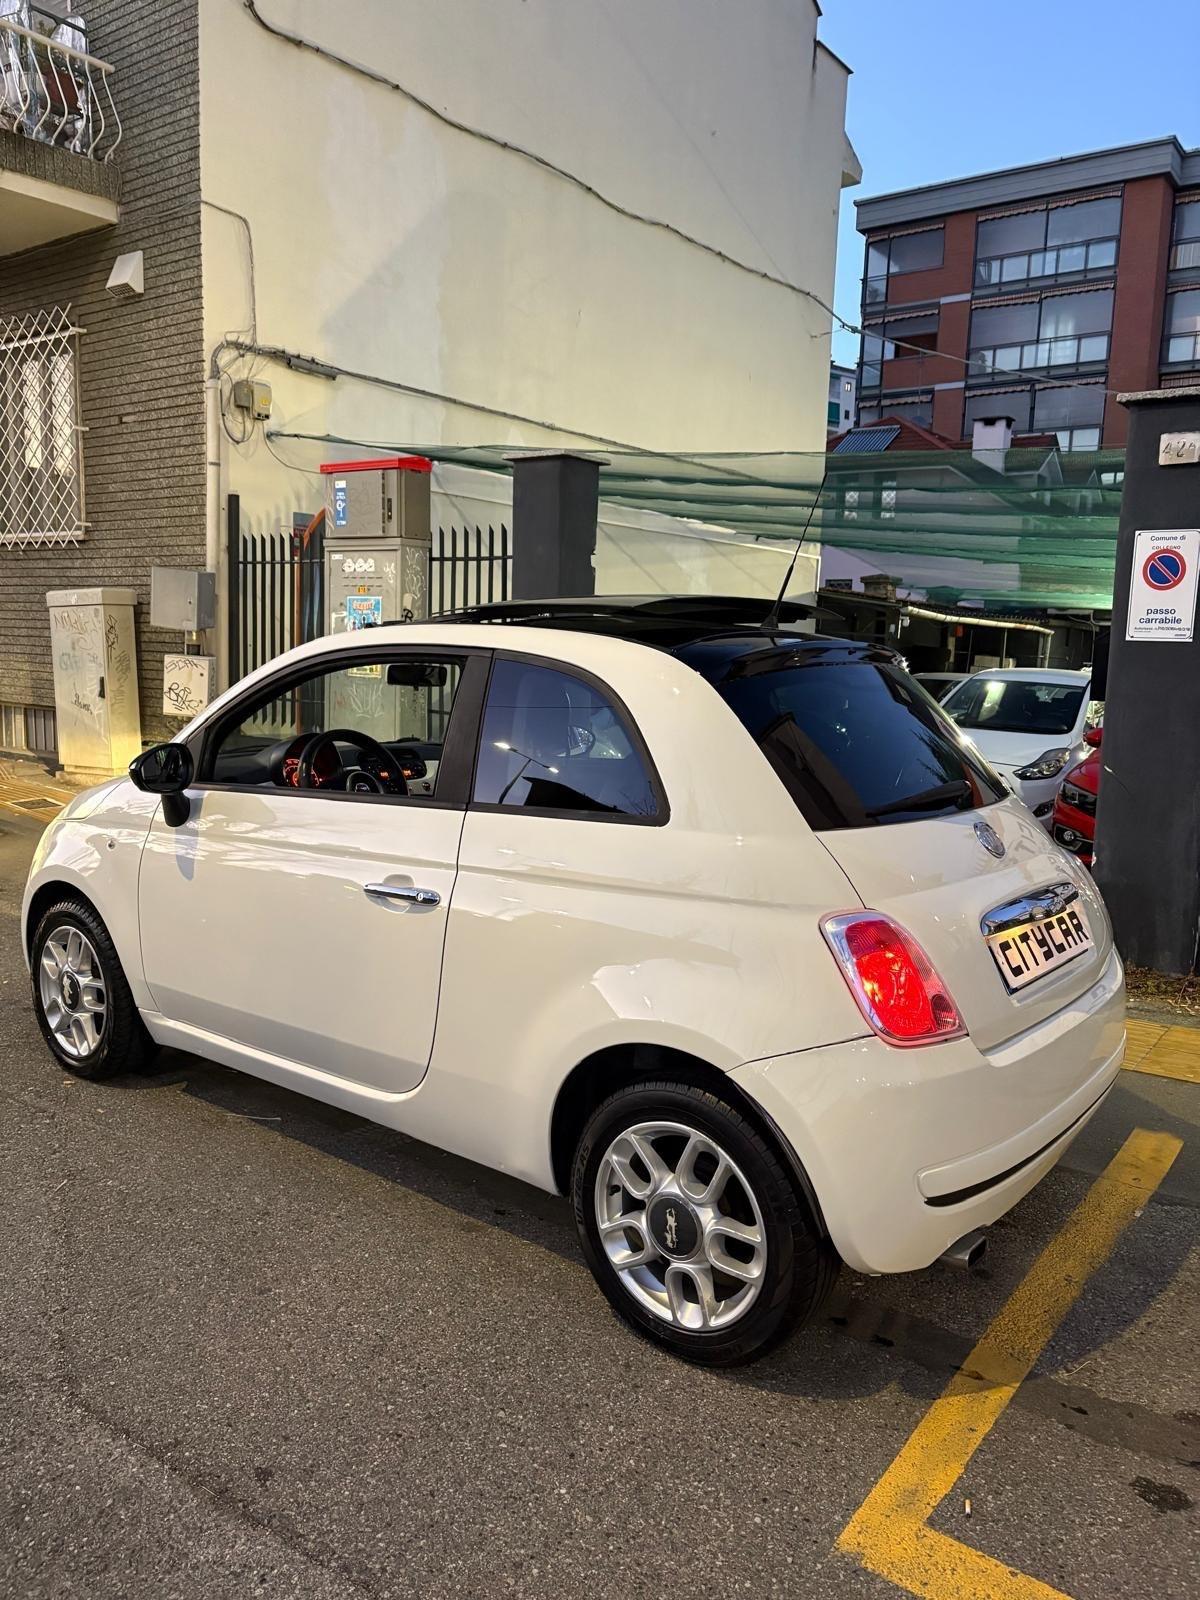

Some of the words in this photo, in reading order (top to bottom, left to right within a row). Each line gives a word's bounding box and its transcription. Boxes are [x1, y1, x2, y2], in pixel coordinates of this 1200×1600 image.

[1146, 607, 1176, 616] passo
[1139, 615, 1182, 625] carrabile
[998, 910, 1090, 978] CITYCAR
